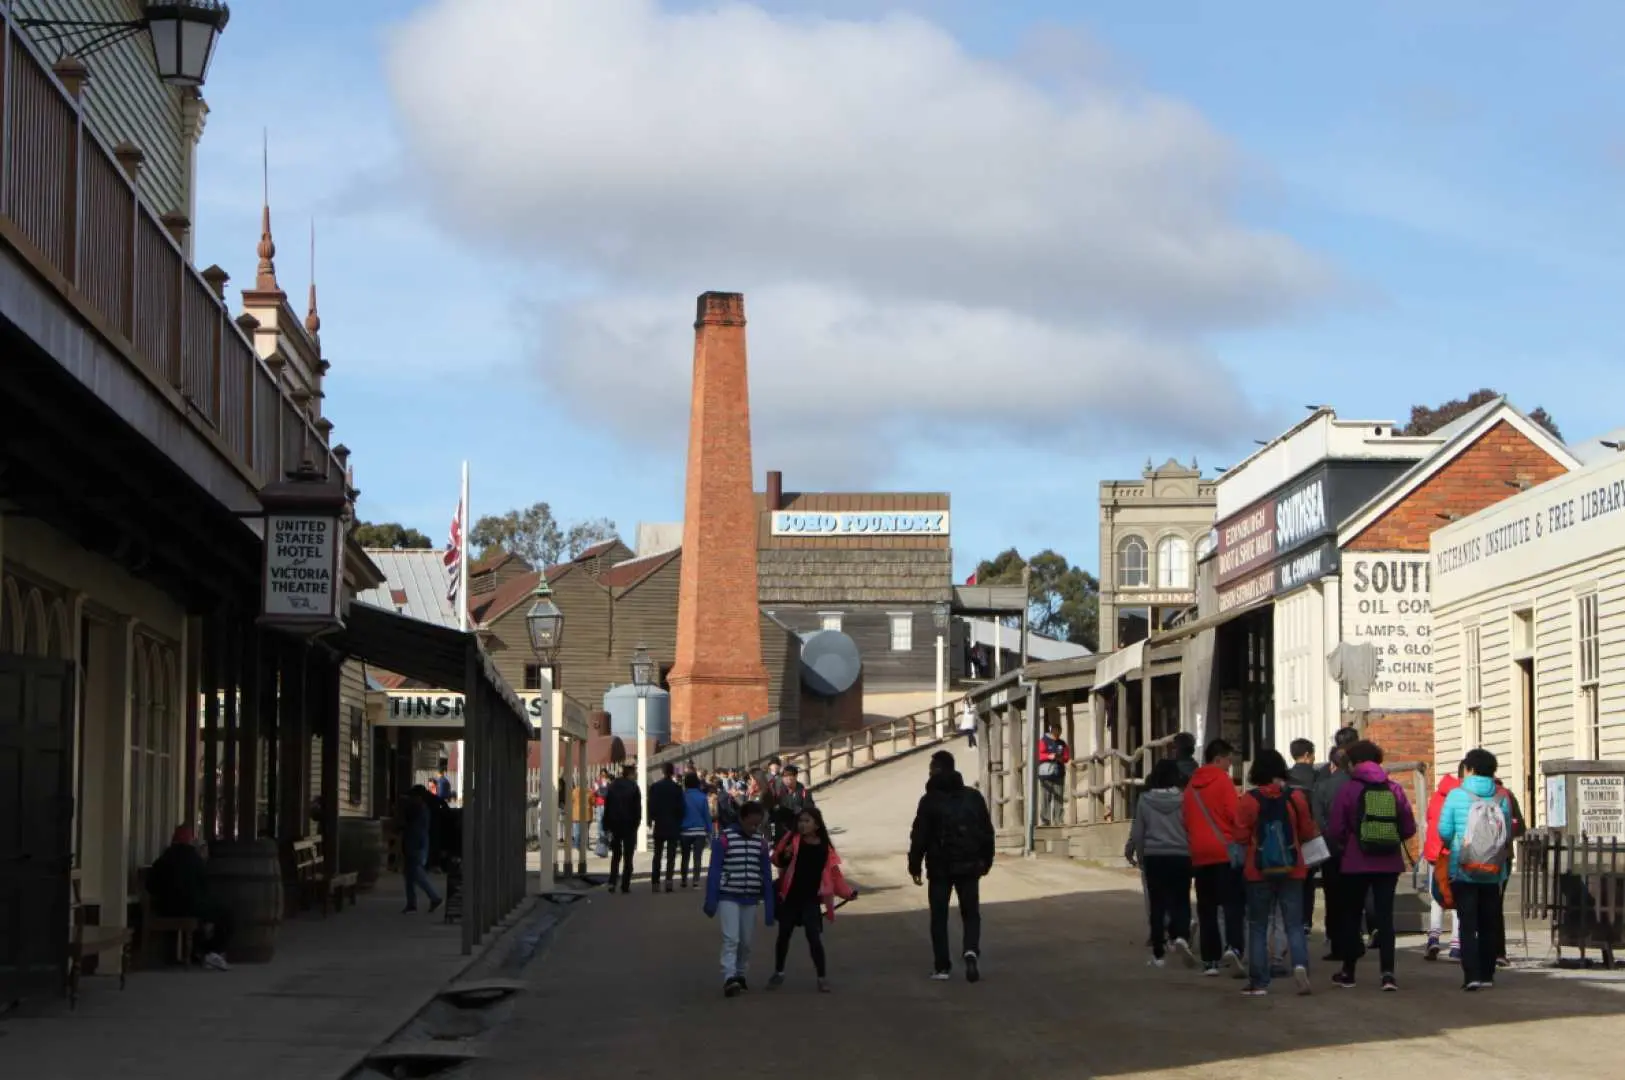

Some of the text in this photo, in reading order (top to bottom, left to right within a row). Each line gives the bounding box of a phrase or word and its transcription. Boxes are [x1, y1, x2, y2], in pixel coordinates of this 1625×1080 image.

[1277, 480, 1326, 549] SOUTHSEA
[275, 520, 326, 532] UNITED
[778, 513, 944, 532] SOHO FOUNDRY
[1436, 479, 1625, 576] MECHANICS INSTITUTE & FREE LIBRARY
[275, 532, 325, 544] STATES
[277, 545, 323, 558] HOTEL
[270, 566, 330, 581] VICTORIA
[271, 581, 329, 594] THEATRE
[1358, 600, 1390, 614] OIL
[1355, 625, 1409, 638] LAMPS,
[1387, 644, 1398, 656] &
[1397, 681, 1421, 694] OIL
